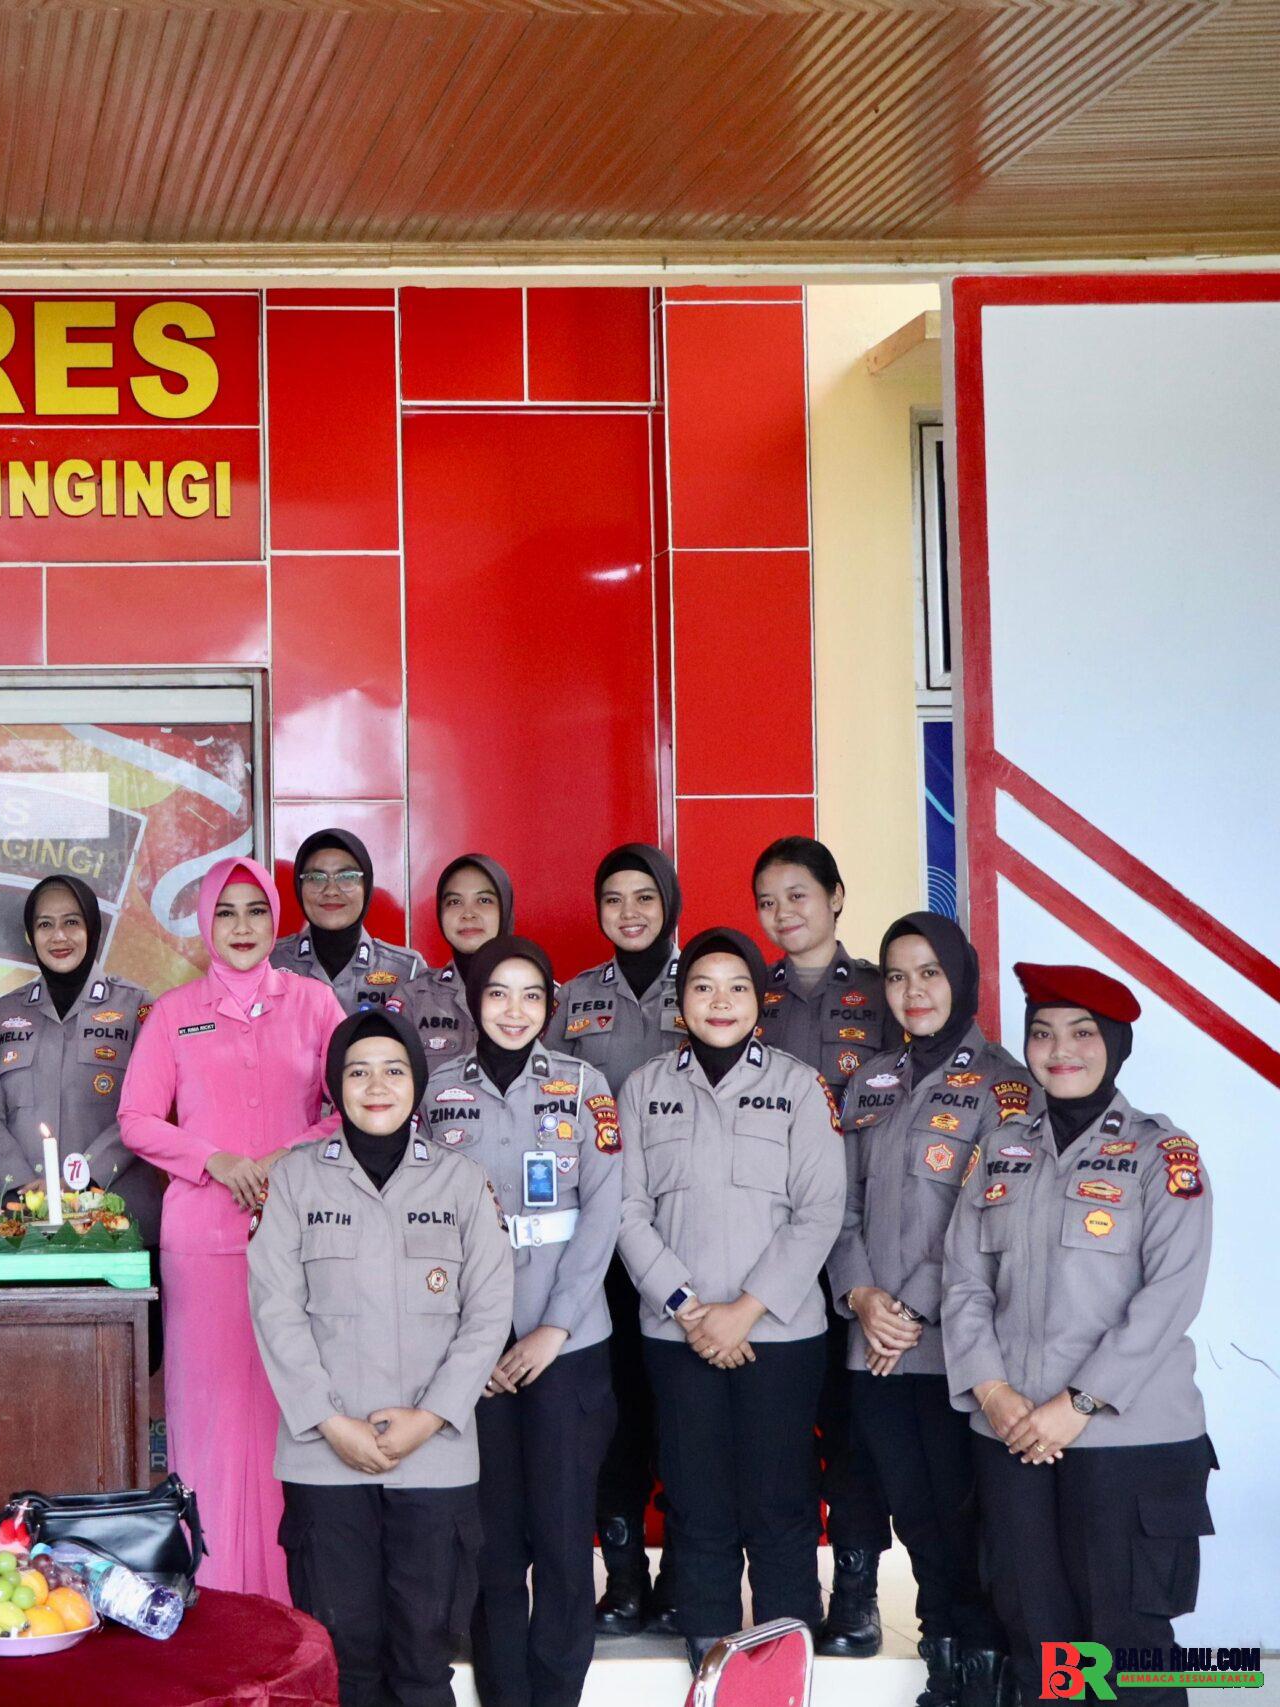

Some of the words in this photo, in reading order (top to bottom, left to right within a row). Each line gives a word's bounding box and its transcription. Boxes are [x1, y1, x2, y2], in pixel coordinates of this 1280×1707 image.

[571, 1000, 614, 1013] FEBI
[830, 1009, 878, 1021] POLRI
[83, 1028, 128, 1041] POLRI
[648, 1101, 684, 1115] EVA
[739, 1096, 792, 1113] POLRI
[858, 1094, 896, 1108] ROLIS
[929, 1093, 979, 1110] POLRI
[430, 1107, 481, 1124] ZIHAN
[1077, 1160, 1138, 1174] POLRI
[308, 1211, 352, 1226] RATIH
[407, 1211, 456, 1226] POLRI
